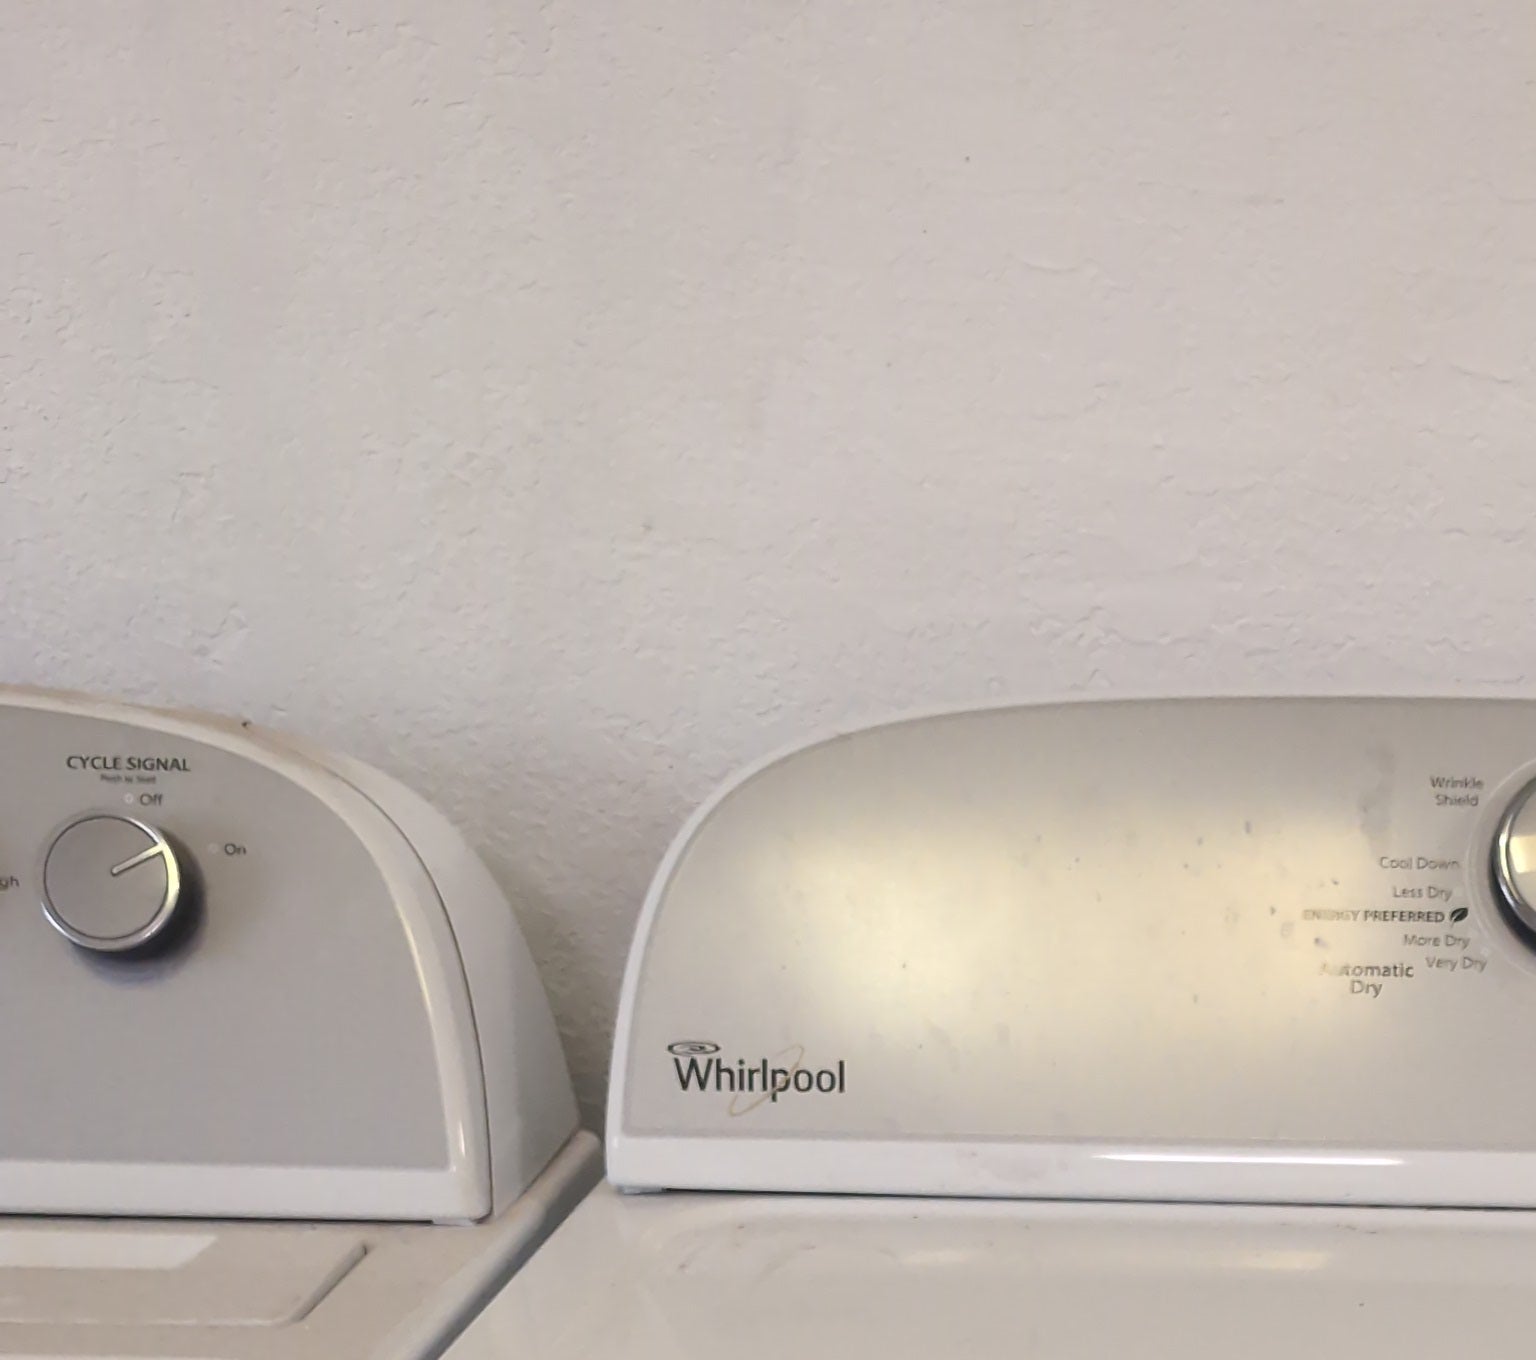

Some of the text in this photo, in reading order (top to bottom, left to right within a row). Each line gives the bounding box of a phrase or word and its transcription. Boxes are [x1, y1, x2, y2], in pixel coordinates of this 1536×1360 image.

[66, 755, 191, 772] CYCLE SIGNAL
[1430, 775, 1484, 789] Wrinkle
[139, 793, 164, 807] Off
[1435, 793, 1479, 807] Shield
[223, 843, 247, 856] On
[1379, 856, 1460, 870] Cool Down
[1392, 885, 1453, 902] Less Dry
[1363, 910, 1446, 923] PREFERRED
[1402, 933, 1471, 949] More Dry
[1318, 962, 1415, 978] Atomatic
[1425, 956, 1488, 972] Very Dry
[1350, 979, 1383, 998] Dry
[673, 1057, 846, 1103] Whirlpool
